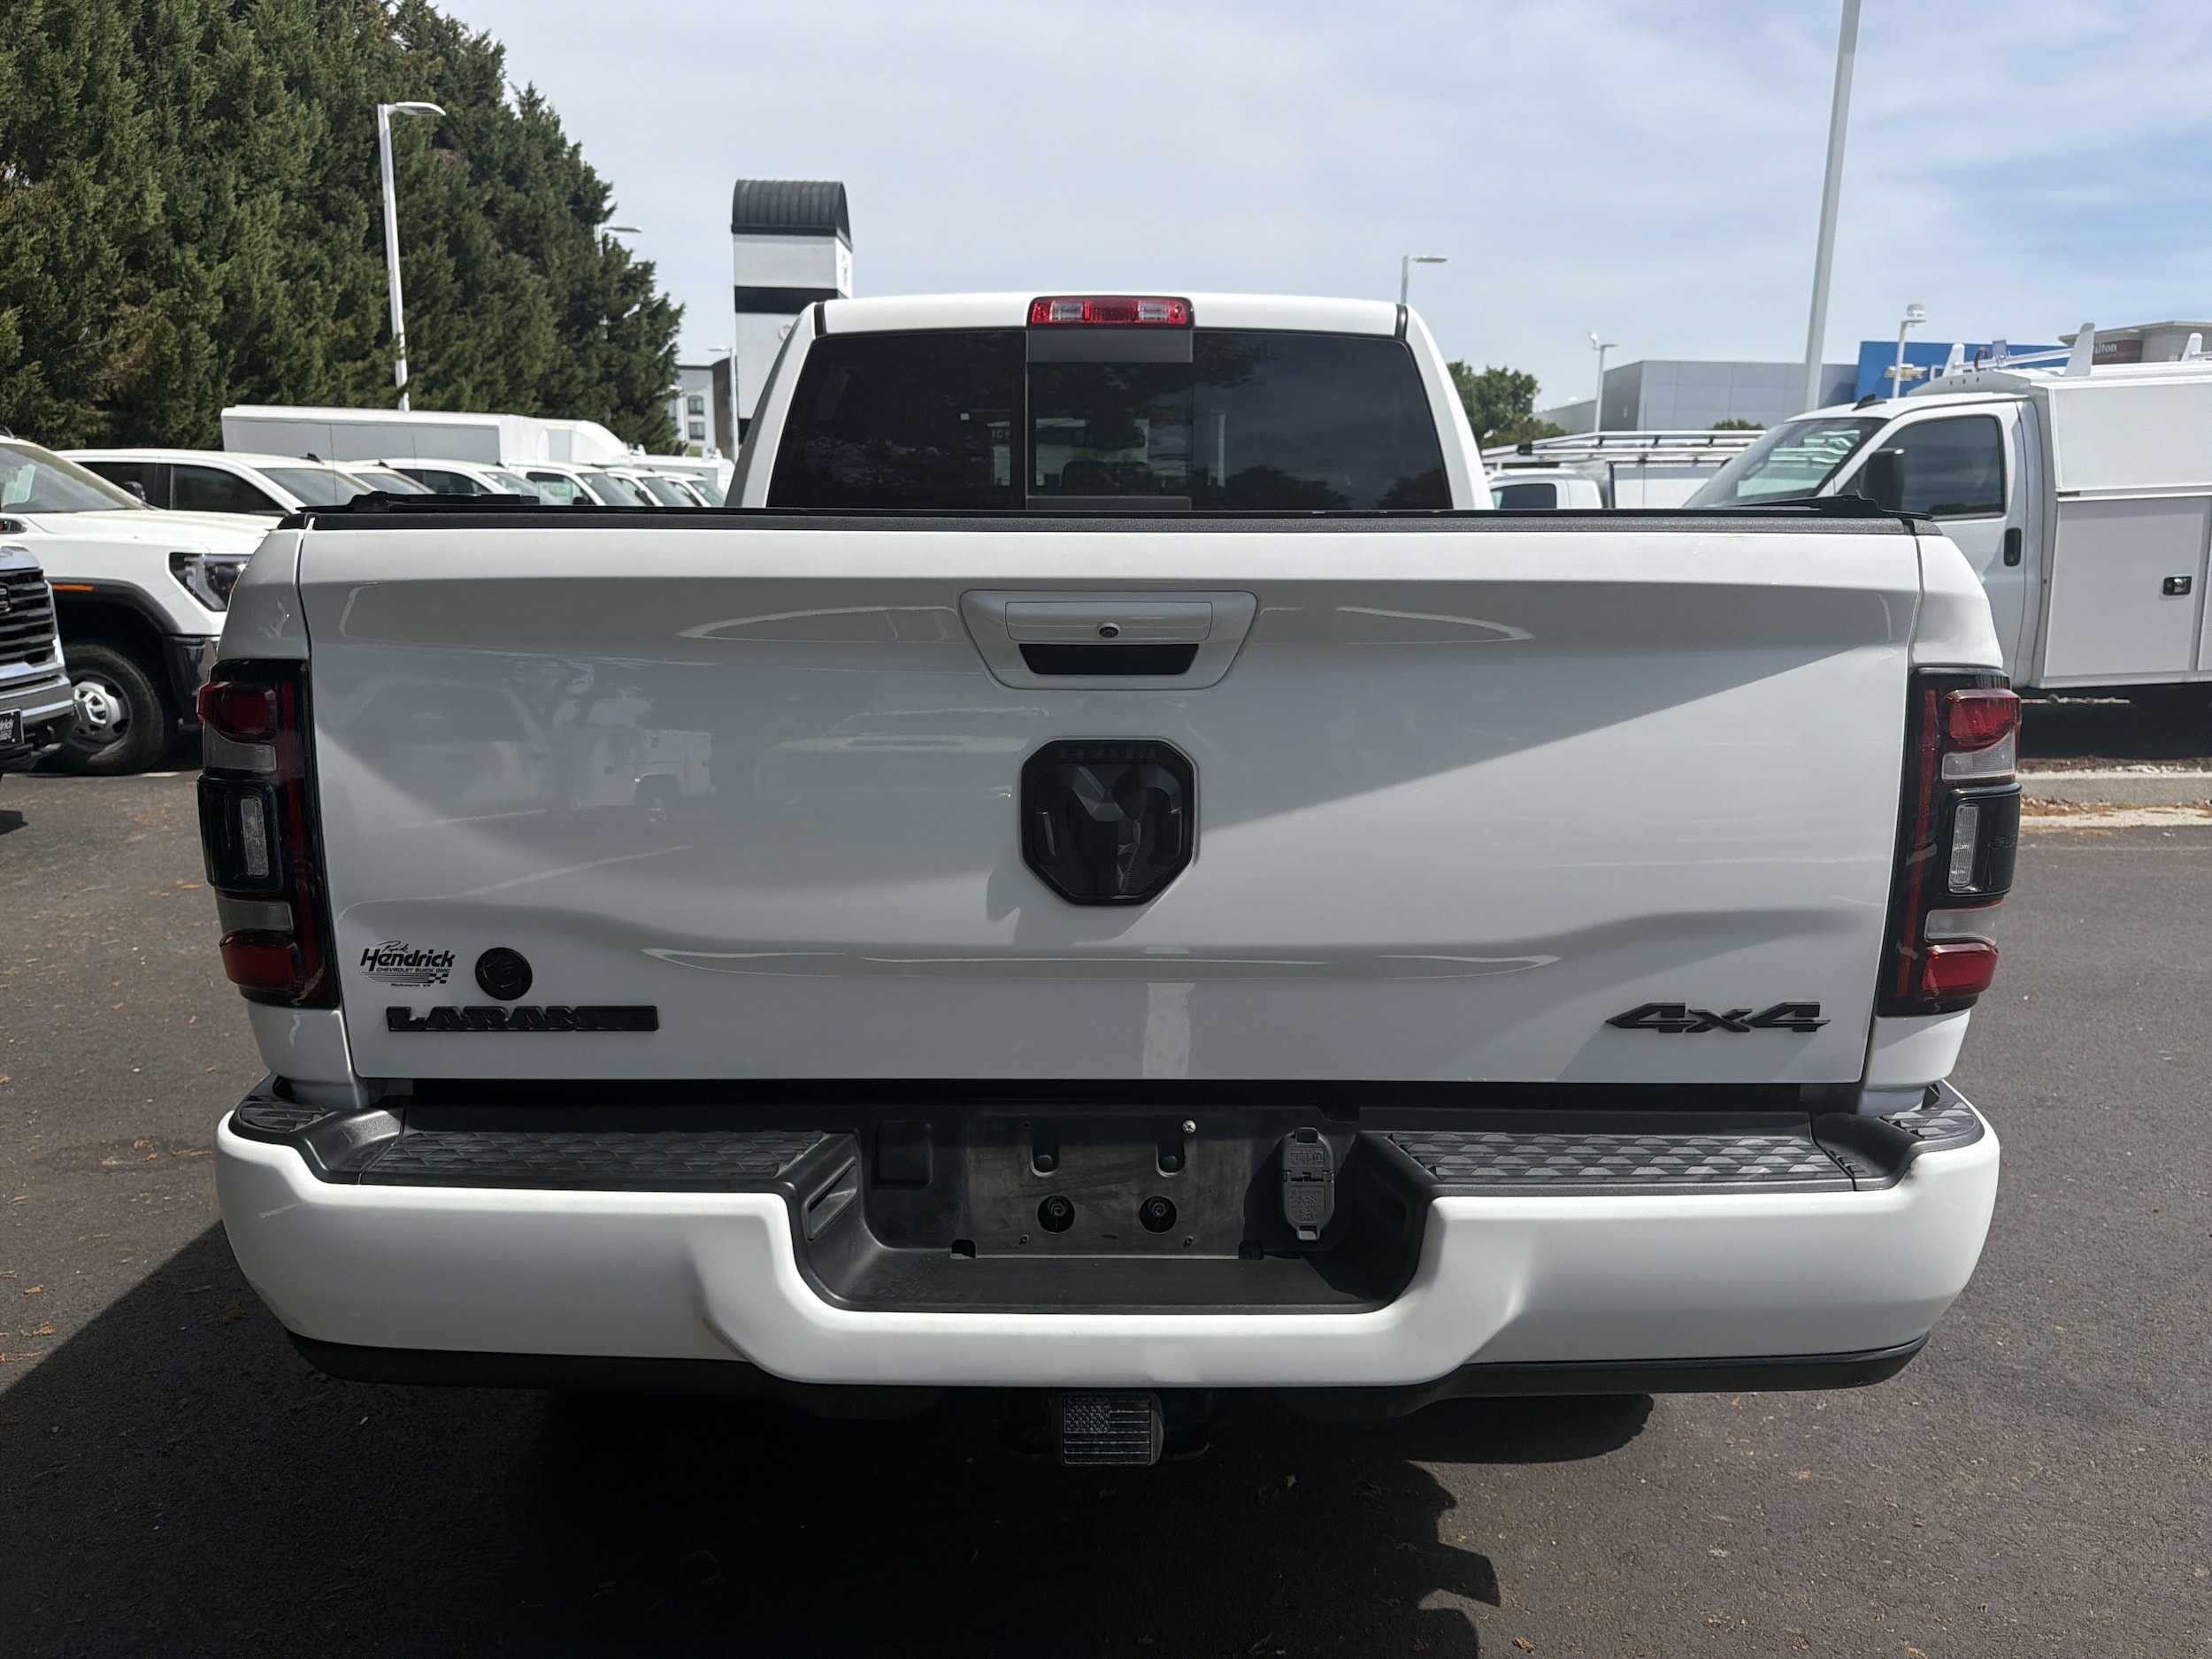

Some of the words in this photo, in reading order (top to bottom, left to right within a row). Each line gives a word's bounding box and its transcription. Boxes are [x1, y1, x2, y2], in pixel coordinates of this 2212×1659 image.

[2094, 342, 2117, 354] ilton
[360, 948, 456, 972] Hendrick
[386, 1006, 659, 1032] LARAM
